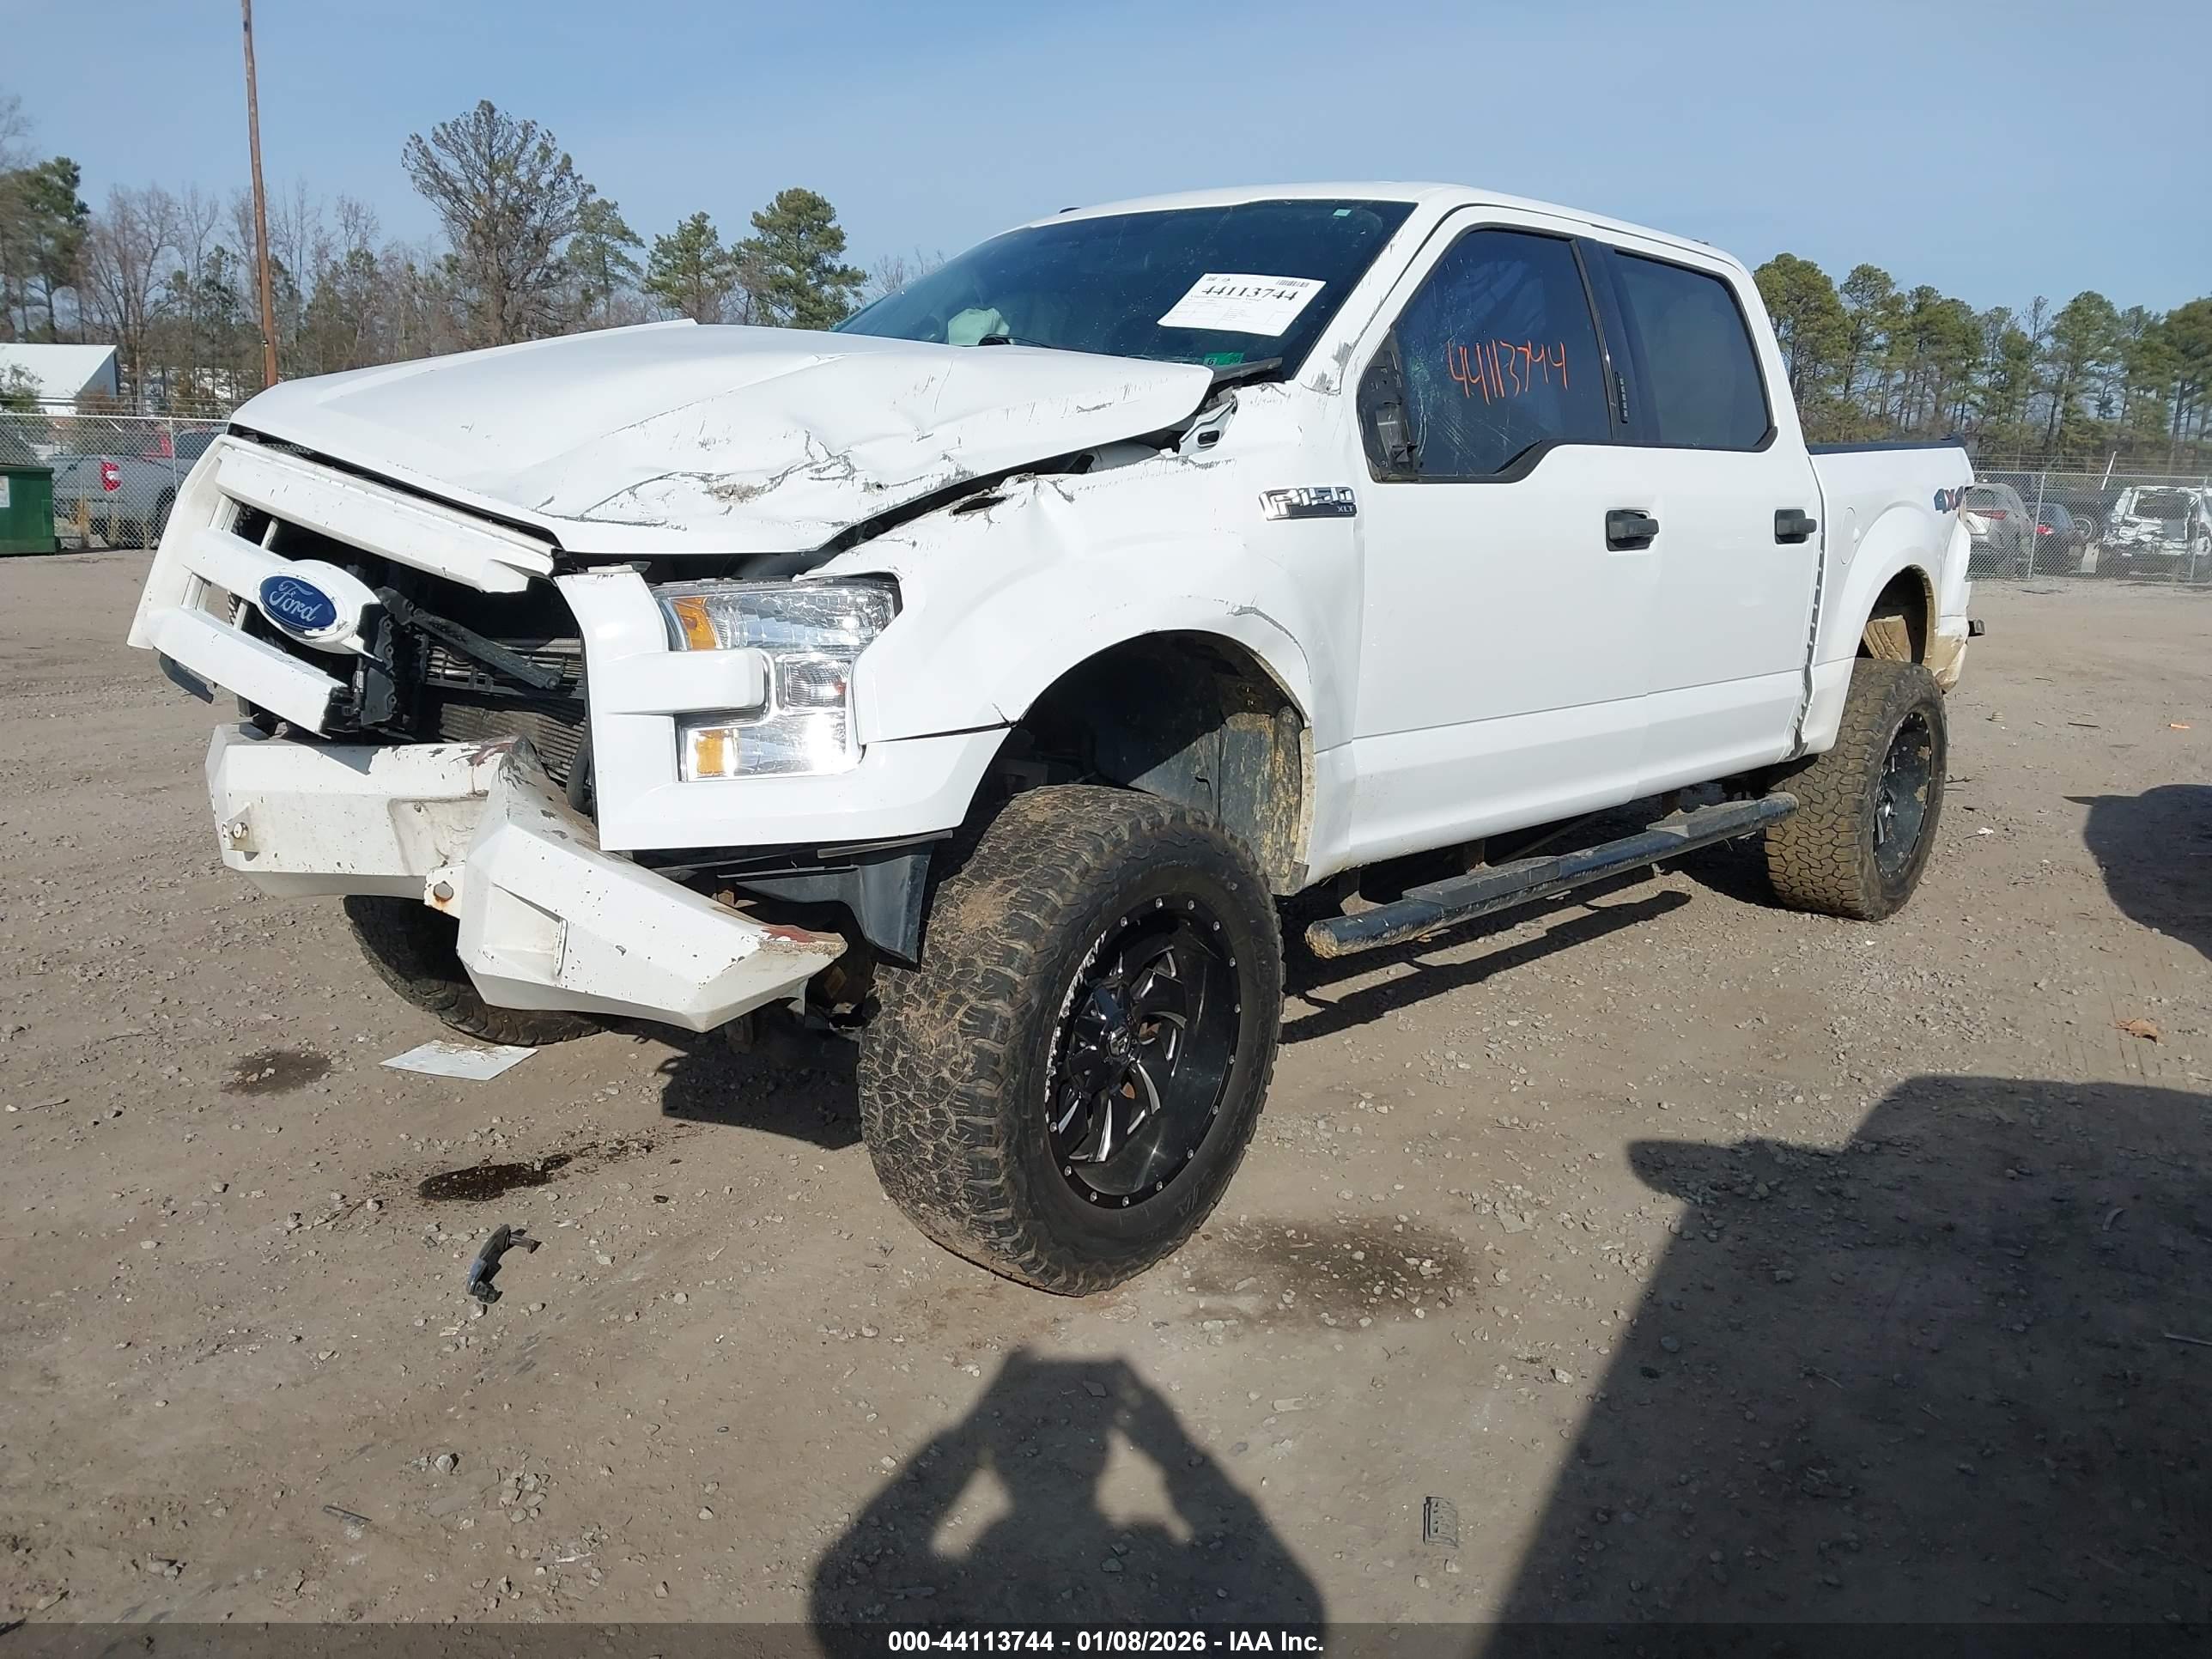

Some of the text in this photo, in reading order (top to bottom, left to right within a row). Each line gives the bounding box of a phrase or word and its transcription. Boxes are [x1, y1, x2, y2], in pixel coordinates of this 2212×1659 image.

[1201, 285, 1299, 301] 44113744
[1447, 339, 1568, 405] 44113744
[269, 580, 323, 623] Ford
